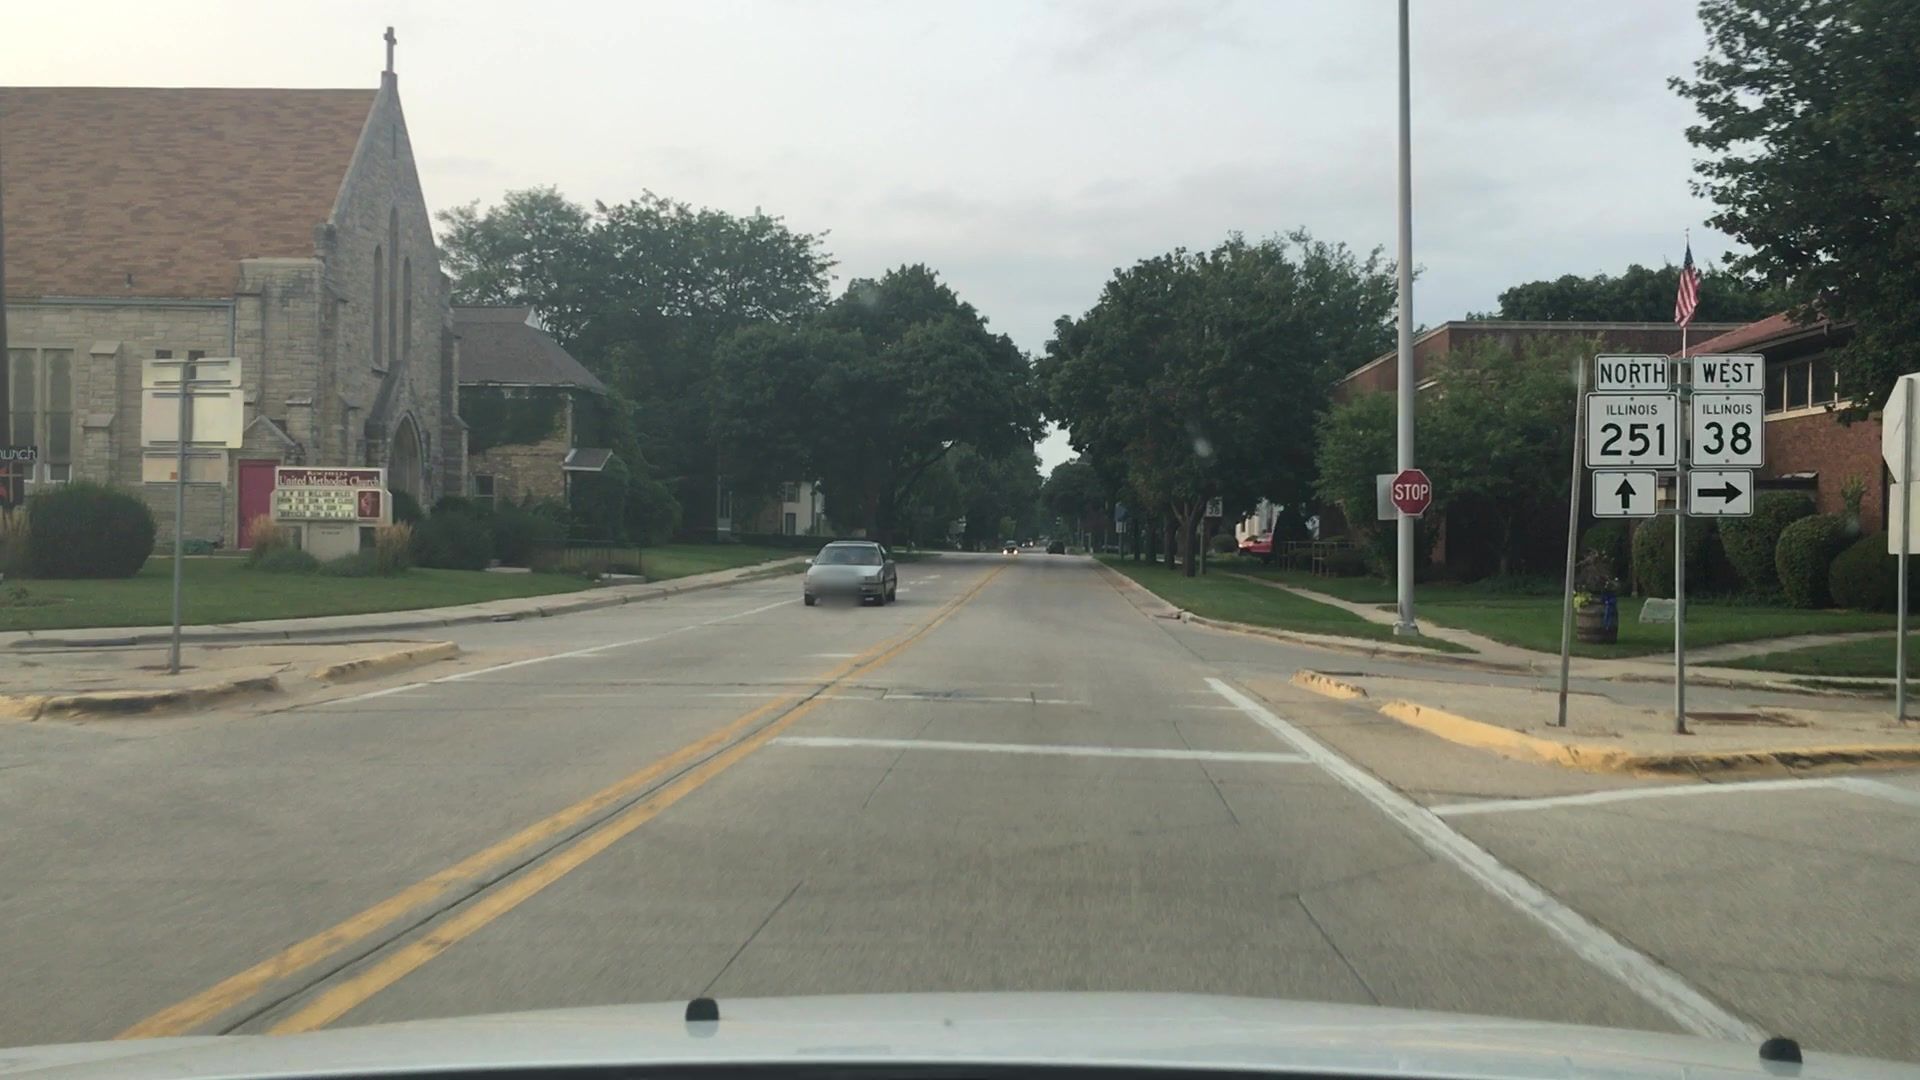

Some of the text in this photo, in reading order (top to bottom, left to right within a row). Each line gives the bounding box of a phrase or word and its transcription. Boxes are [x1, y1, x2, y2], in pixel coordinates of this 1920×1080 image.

[1600, 362, 1666, 384] NORTH
[1702, 362, 1755, 384] WEST
[1606, 404, 1658, 416] ILLINOIS
[1702, 403, 1753, 415] ILLINOIS
[1600, 422, 1665, 456] 251
[1702, 421, 1752, 455] 38
[279, 475, 379, 487] United Methodist Church
[1394, 483, 1429, 501] STOP
